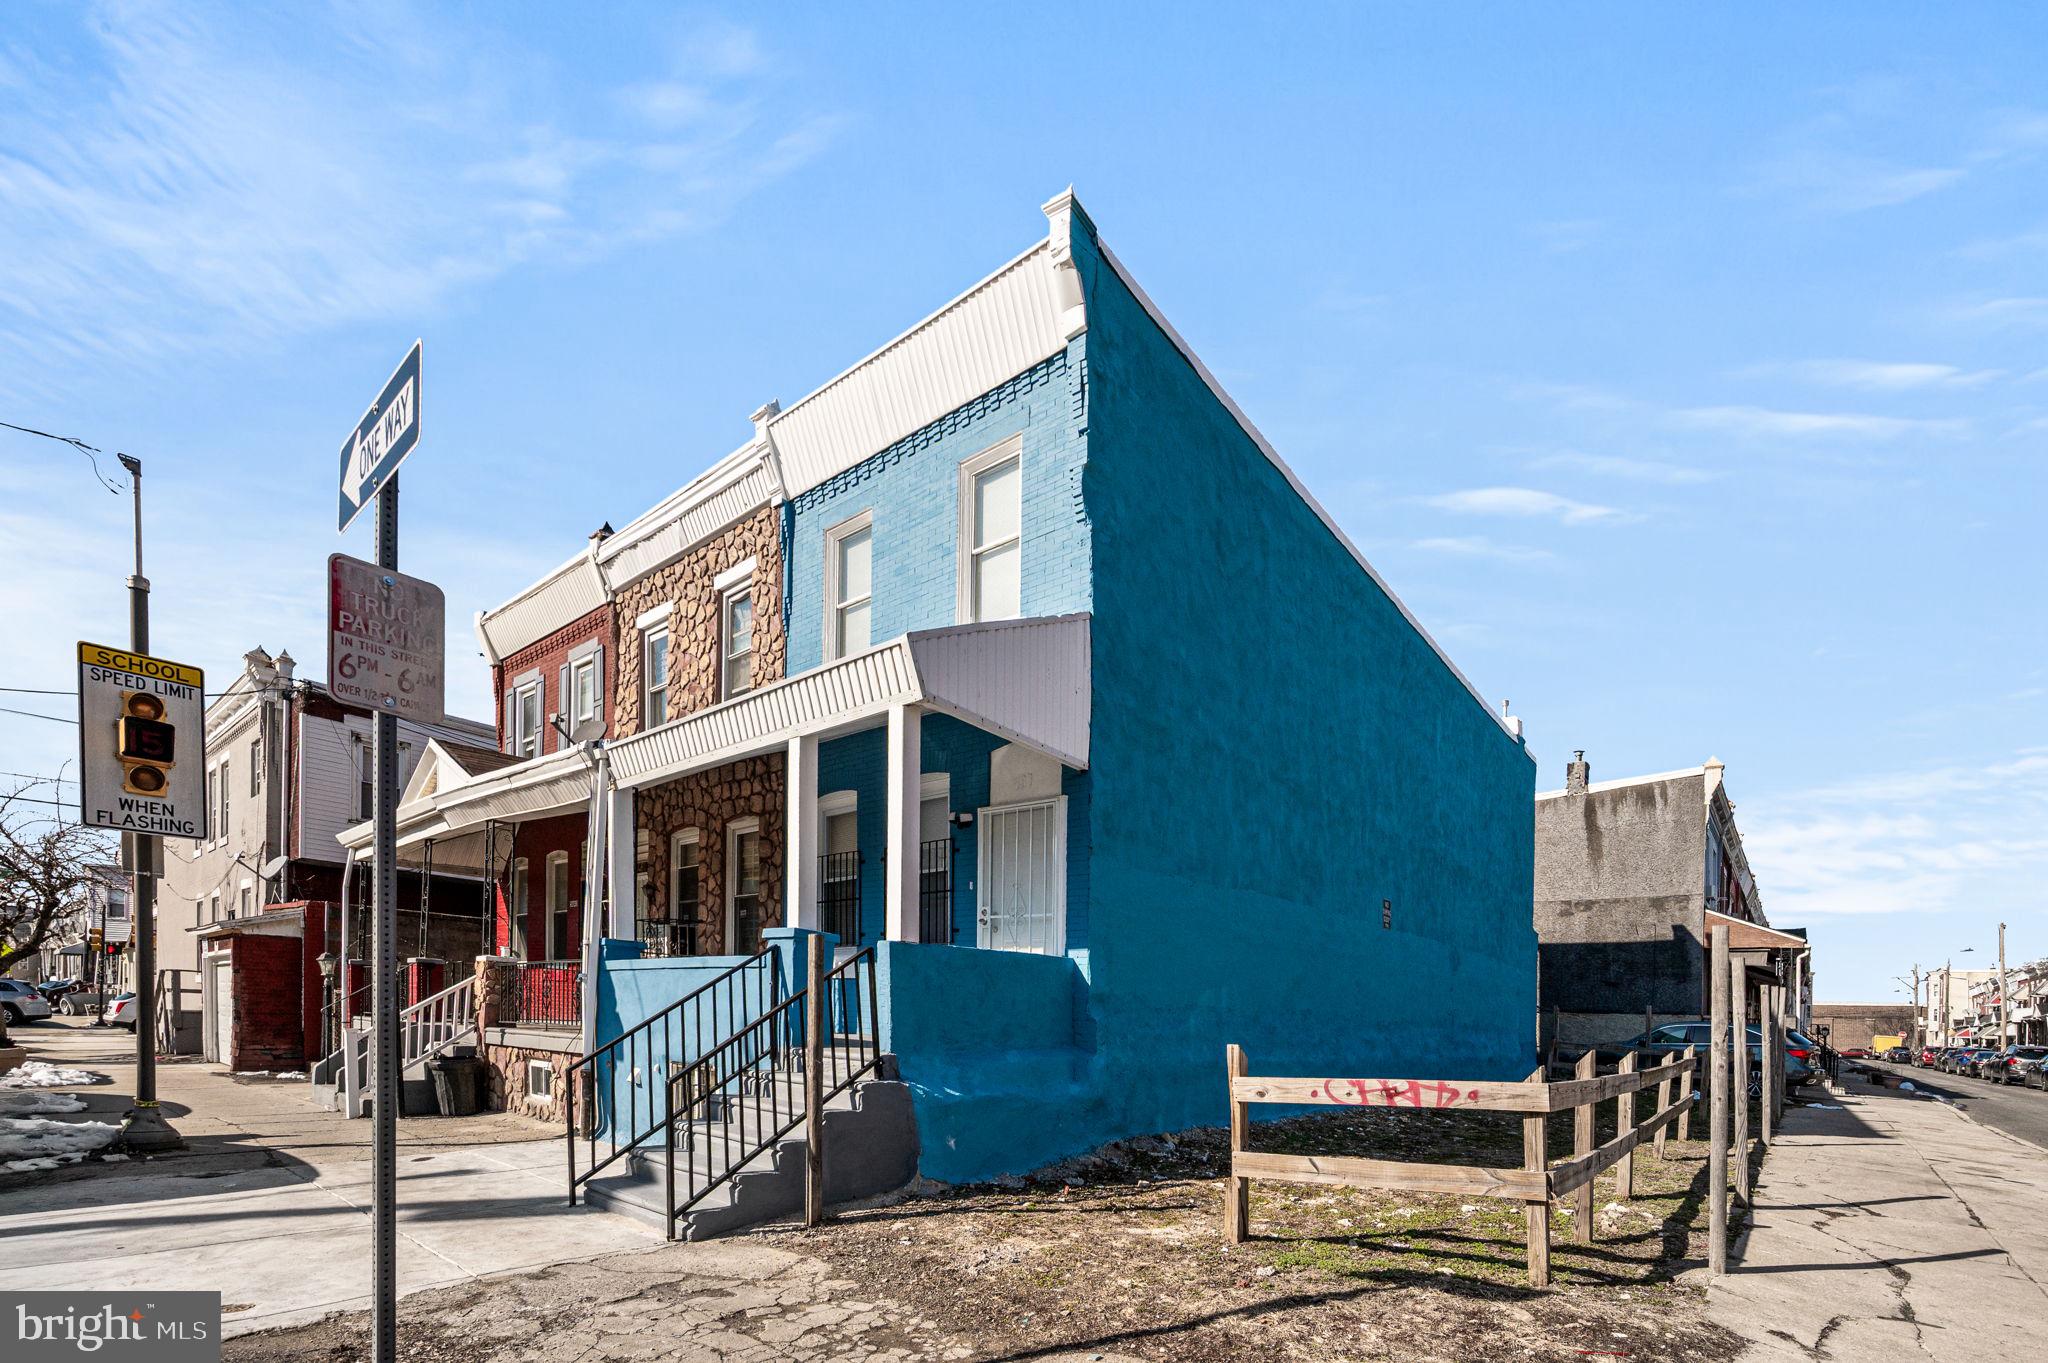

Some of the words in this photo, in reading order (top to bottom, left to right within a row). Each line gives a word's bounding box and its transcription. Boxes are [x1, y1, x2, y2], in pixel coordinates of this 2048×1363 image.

[359, 425, 381, 480] ONE
[384, 386, 410, 447] WAY
[351, 591, 424, 628] TRUCK
[339, 610, 436, 650] PARKING
[97, 651, 189, 683] SCHOOL
[341, 635, 353, 648] IN
[359, 639, 386, 655] THIS
[391, 649, 433, 669] STREE
[90, 667, 146, 690] SPEED
[155, 681, 195, 701] LIMIT
[337, 682, 361, 696] OVER
[96, 809, 195, 834] FLASHING
[119, 797, 175, 817] WHEN
